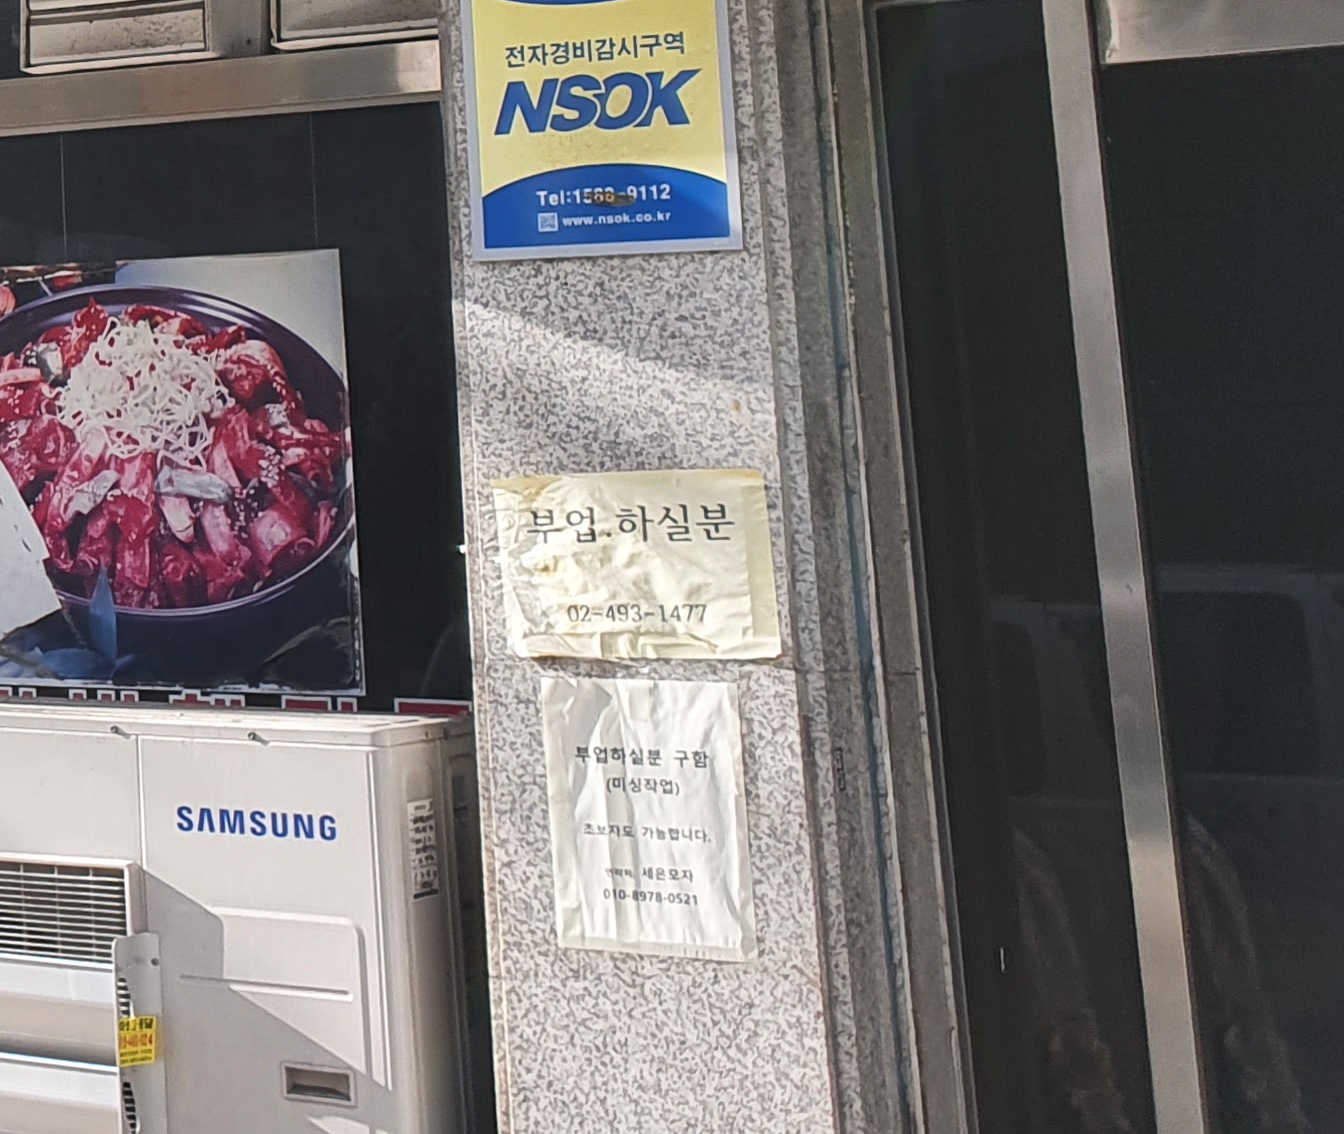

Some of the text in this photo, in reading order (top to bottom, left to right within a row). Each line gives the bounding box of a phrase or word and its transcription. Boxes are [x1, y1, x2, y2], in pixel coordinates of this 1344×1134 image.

[504, 30, 686, 69] 전자경비감시구역
[493, 68, 702, 137] NSOK
[562, 210, 672, 228] www.nsok.co.kr
[566, 603, 708, 624] 02-493-1477
[574, 746, 709, 769] 부업하실분 구함
[605, 777, 680, 796] (미싱작업)
[176, 804, 338, 842] SAMSUNG
[602, 888, 699, 907] 010-8978-0521
